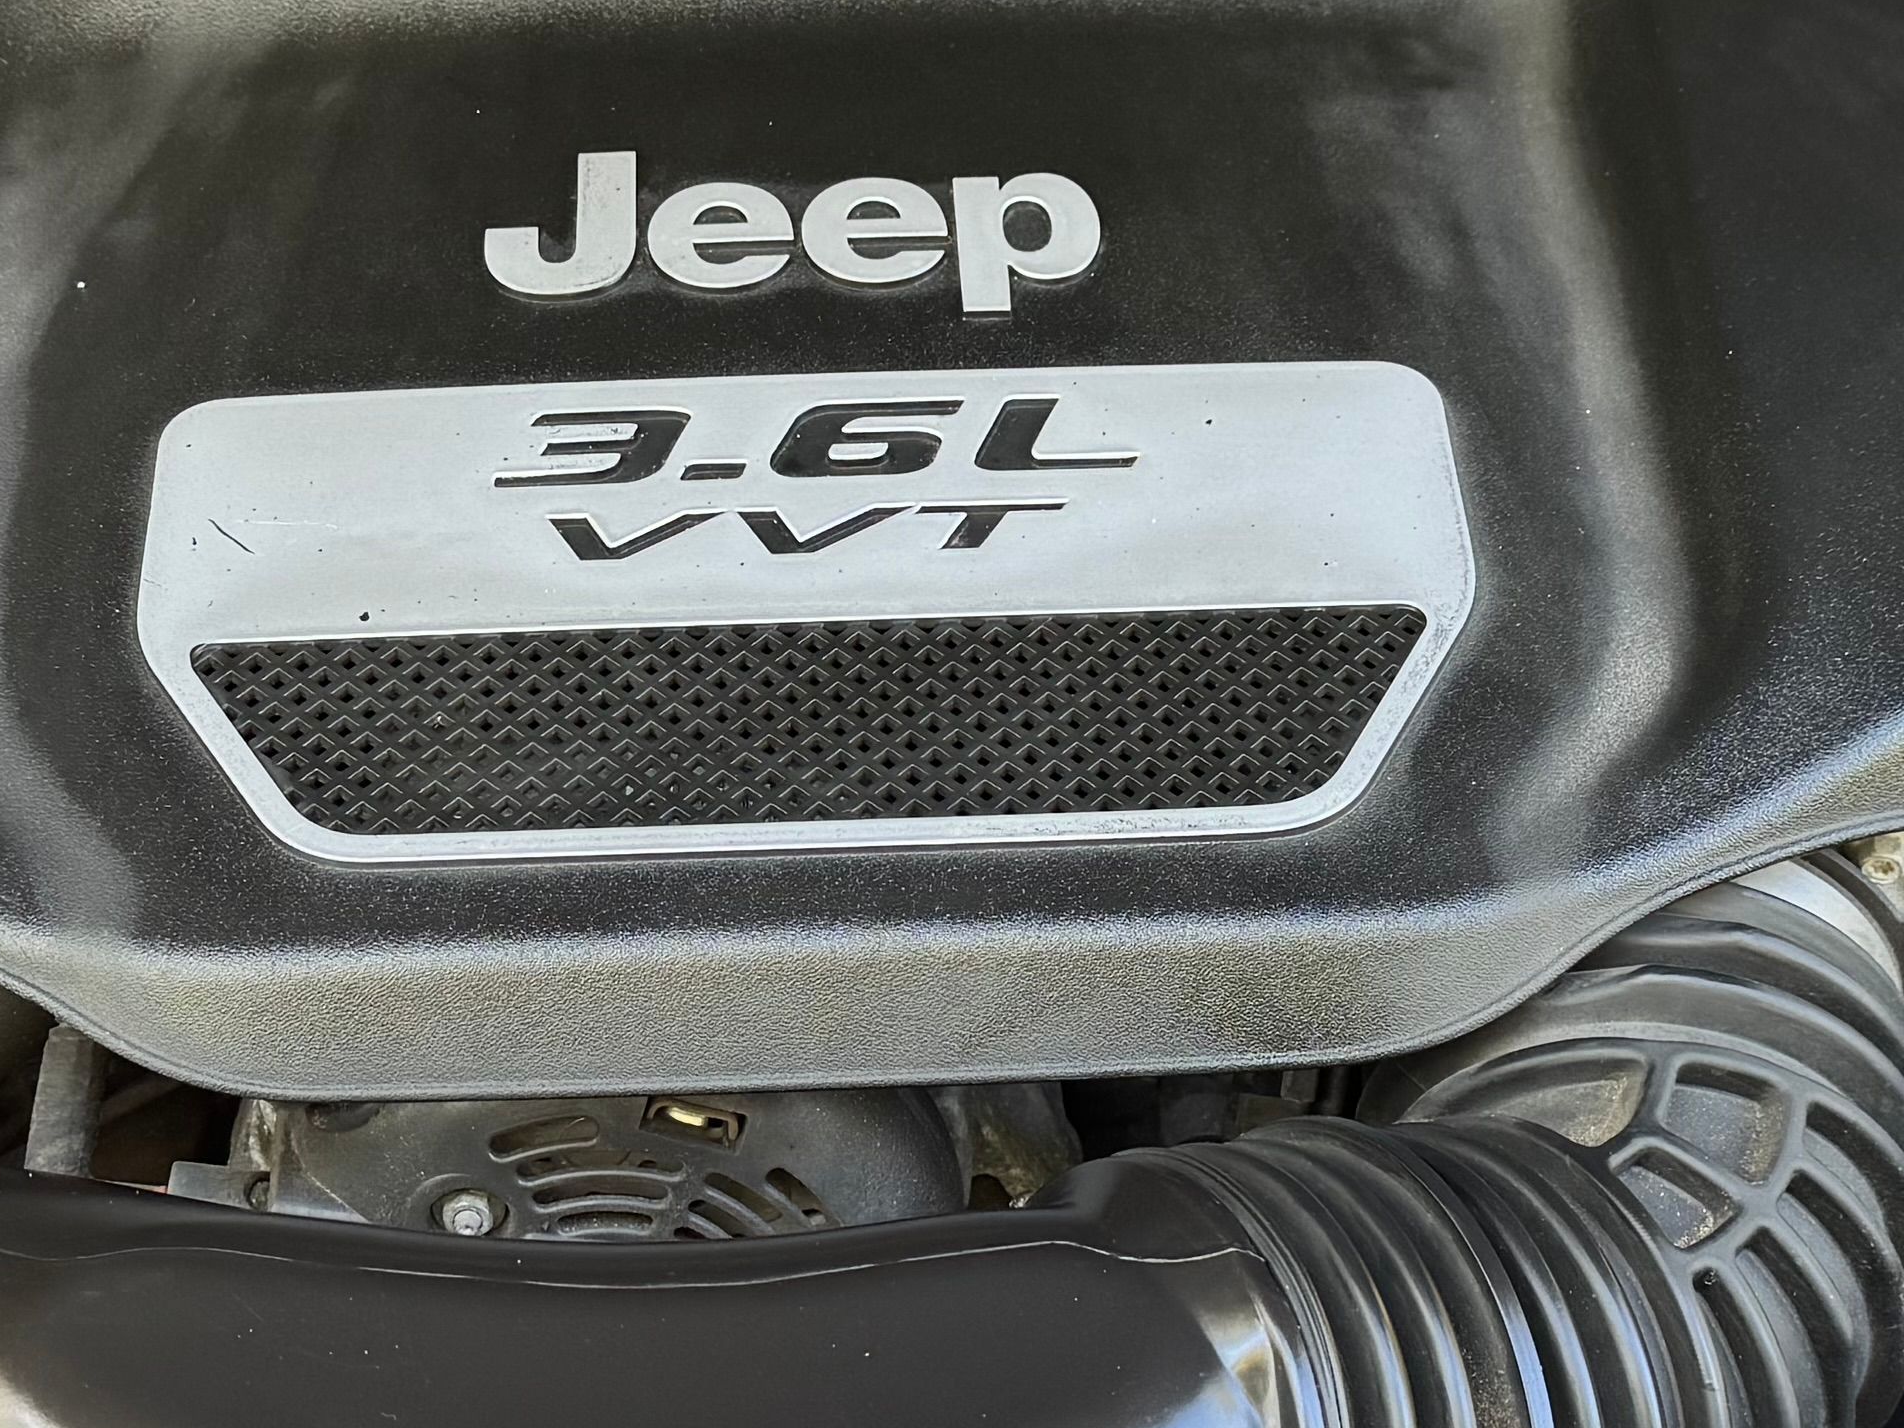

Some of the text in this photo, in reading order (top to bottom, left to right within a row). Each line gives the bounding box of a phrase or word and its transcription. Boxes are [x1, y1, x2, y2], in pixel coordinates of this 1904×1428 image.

[484, 150, 1101, 319] Jeep
[494, 396, 1140, 488] 3.6L
[548, 495, 1070, 562] VVT
